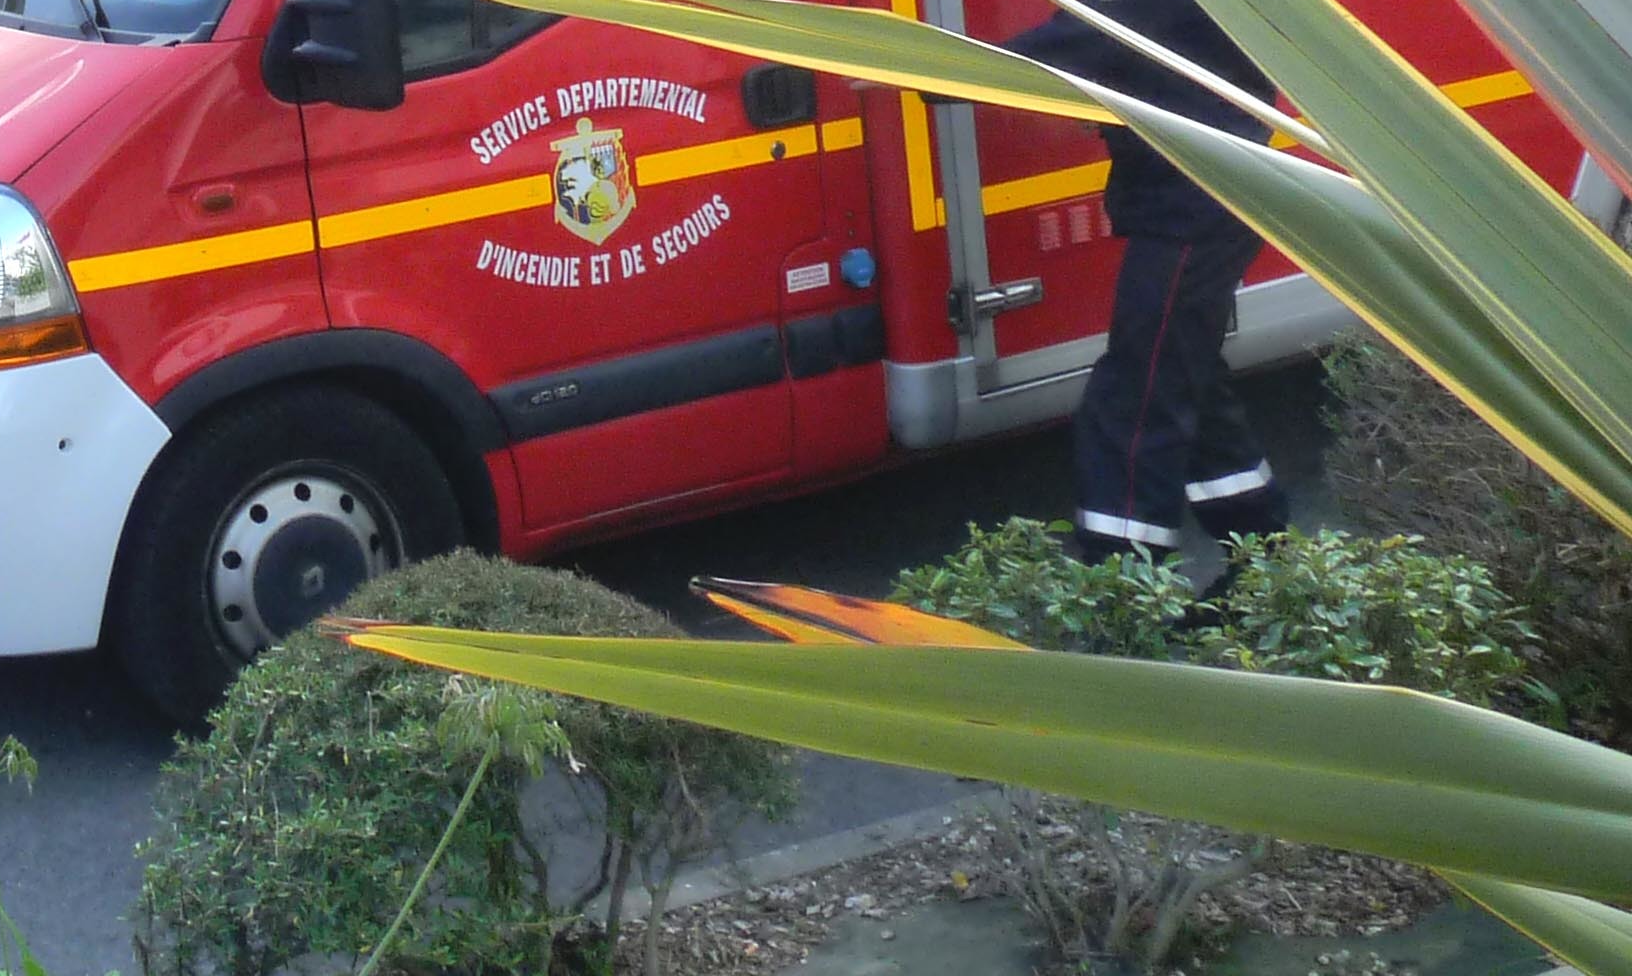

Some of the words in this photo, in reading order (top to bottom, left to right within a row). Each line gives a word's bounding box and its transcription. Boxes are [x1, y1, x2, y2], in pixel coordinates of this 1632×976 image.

[469, 94, 552, 165] SERVICE
[556, 77, 706, 124] DEPARTEMENTAL
[475, 238, 581, 288] D'INCENDIE
[589, 252, 612, 285] ET
[619, 248, 646, 280] DE
[651, 193, 732, 266] SECOURS
